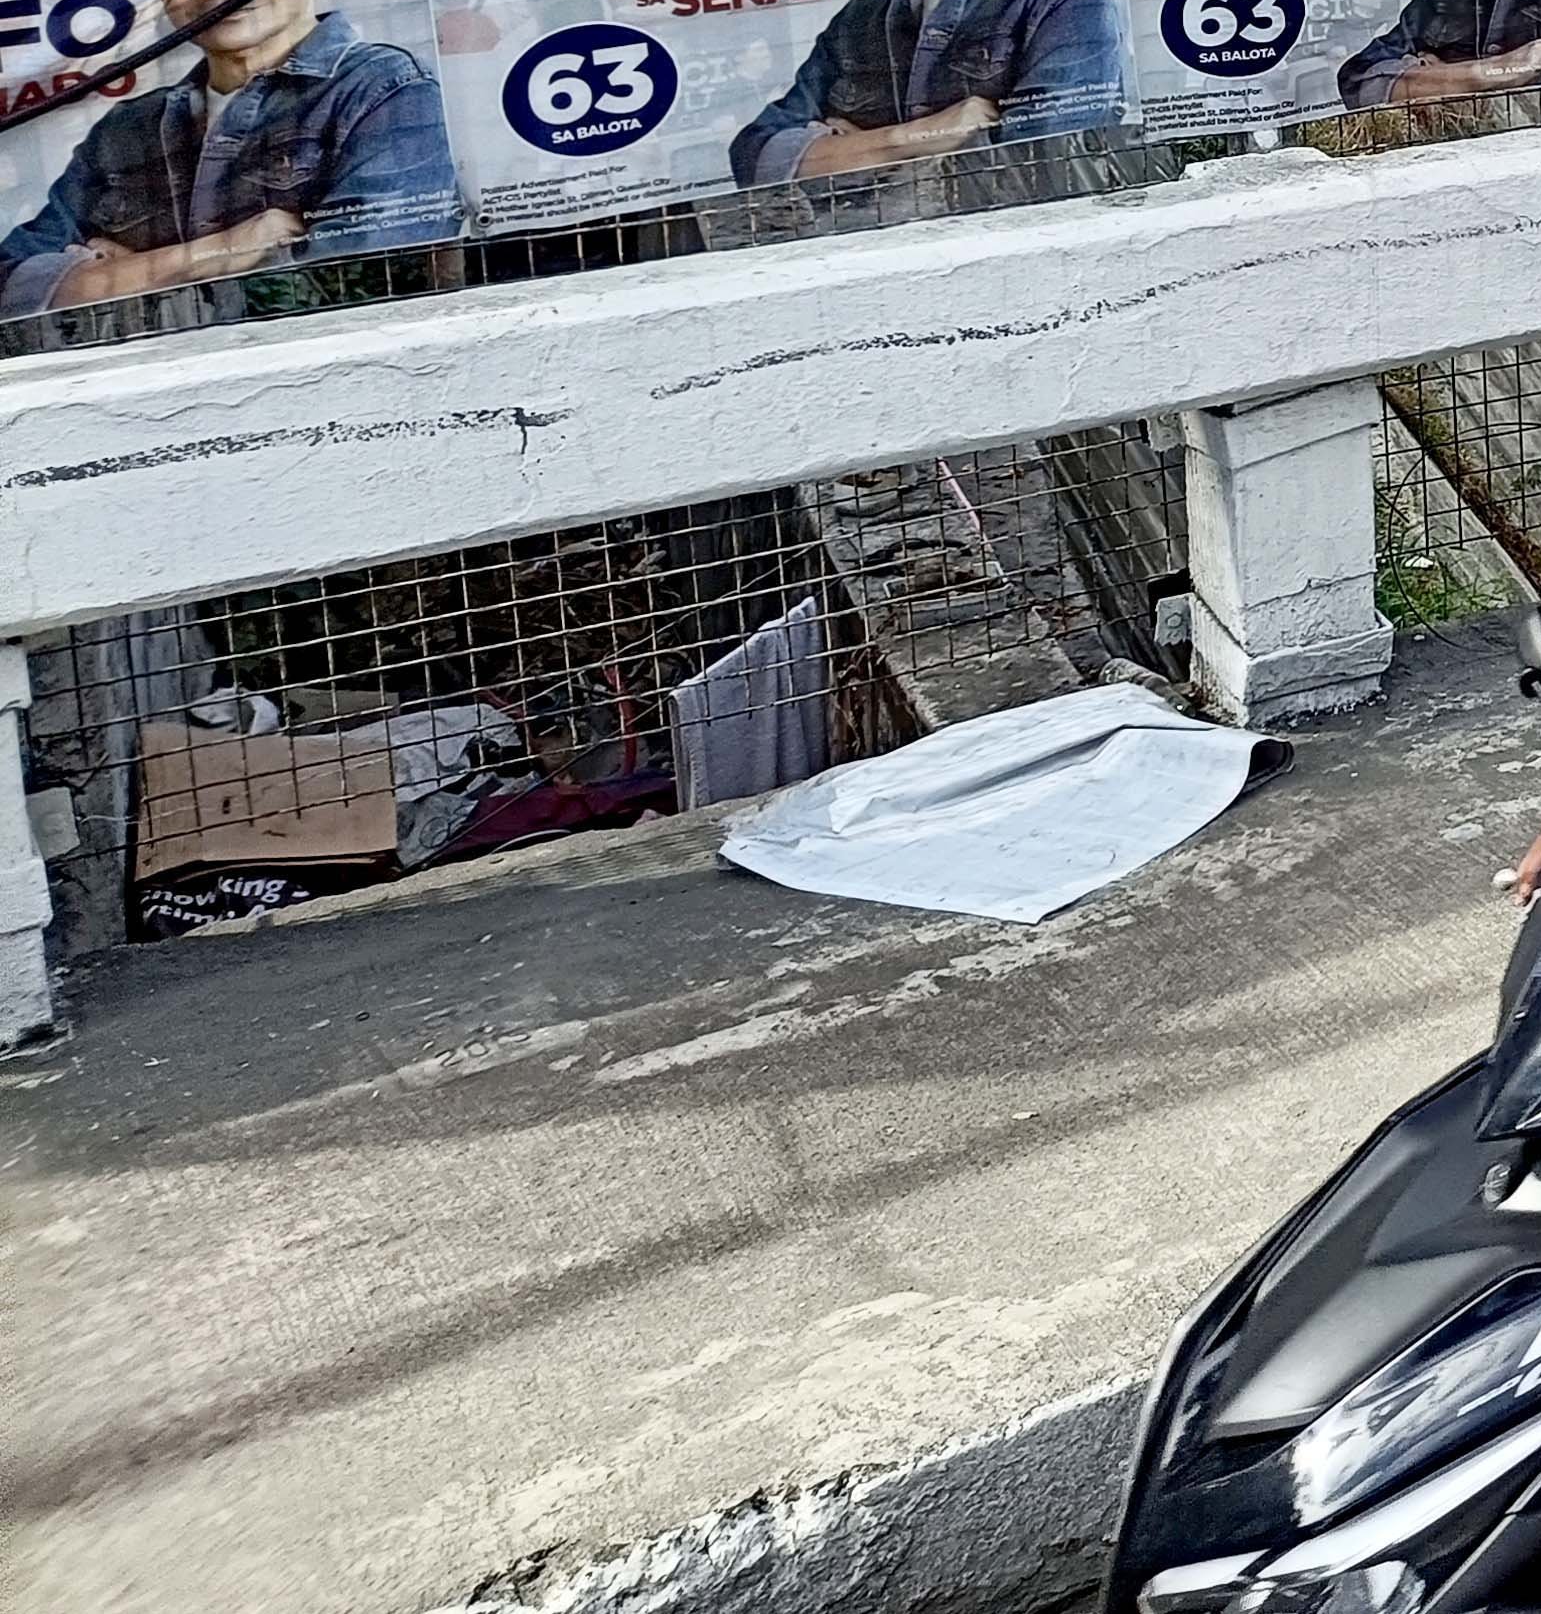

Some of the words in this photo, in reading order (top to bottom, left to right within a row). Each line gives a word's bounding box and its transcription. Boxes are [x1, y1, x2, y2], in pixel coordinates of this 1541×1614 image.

[1199, 51, 1217, 64] SA
[1220, 47, 1276, 63] BALOTA
[528, 41, 656, 126] 63
[551, 129, 573, 145] SA
[576, 118, 642, 141] BALOTA
